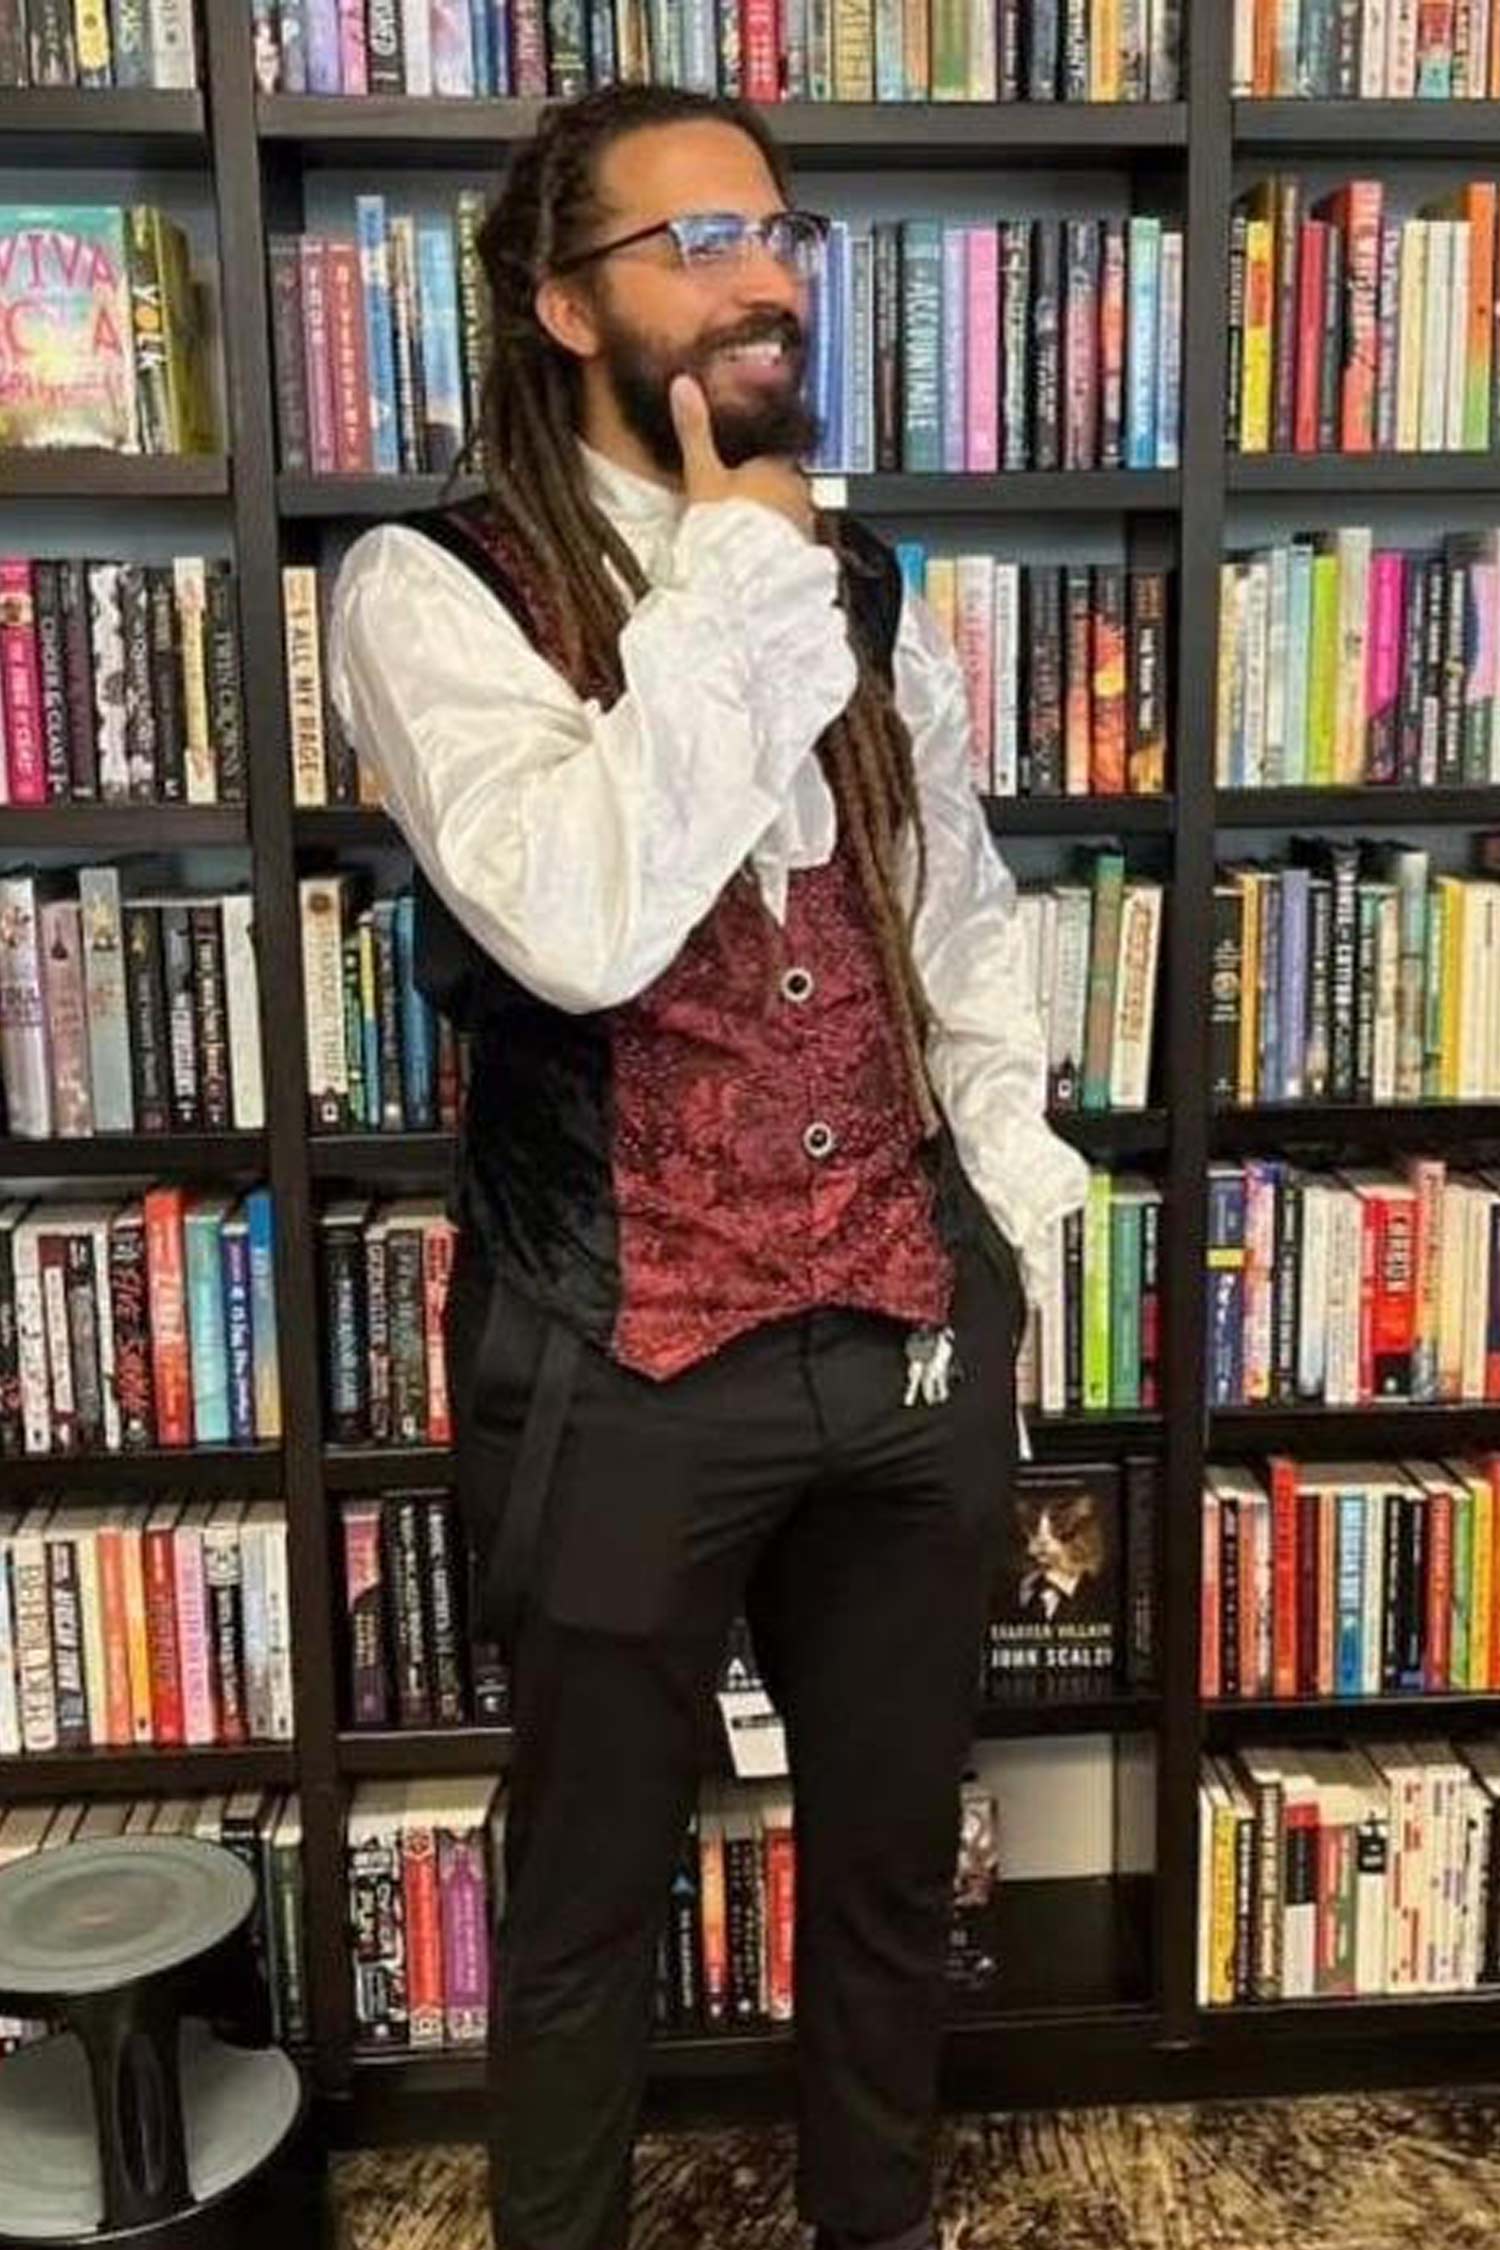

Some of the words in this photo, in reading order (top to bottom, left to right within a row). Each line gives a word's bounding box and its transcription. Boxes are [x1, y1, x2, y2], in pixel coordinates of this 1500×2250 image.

[292, 628, 312, 666] ALL
[296, 676, 316, 706] MY
[297, 716, 321, 774] RAGE
